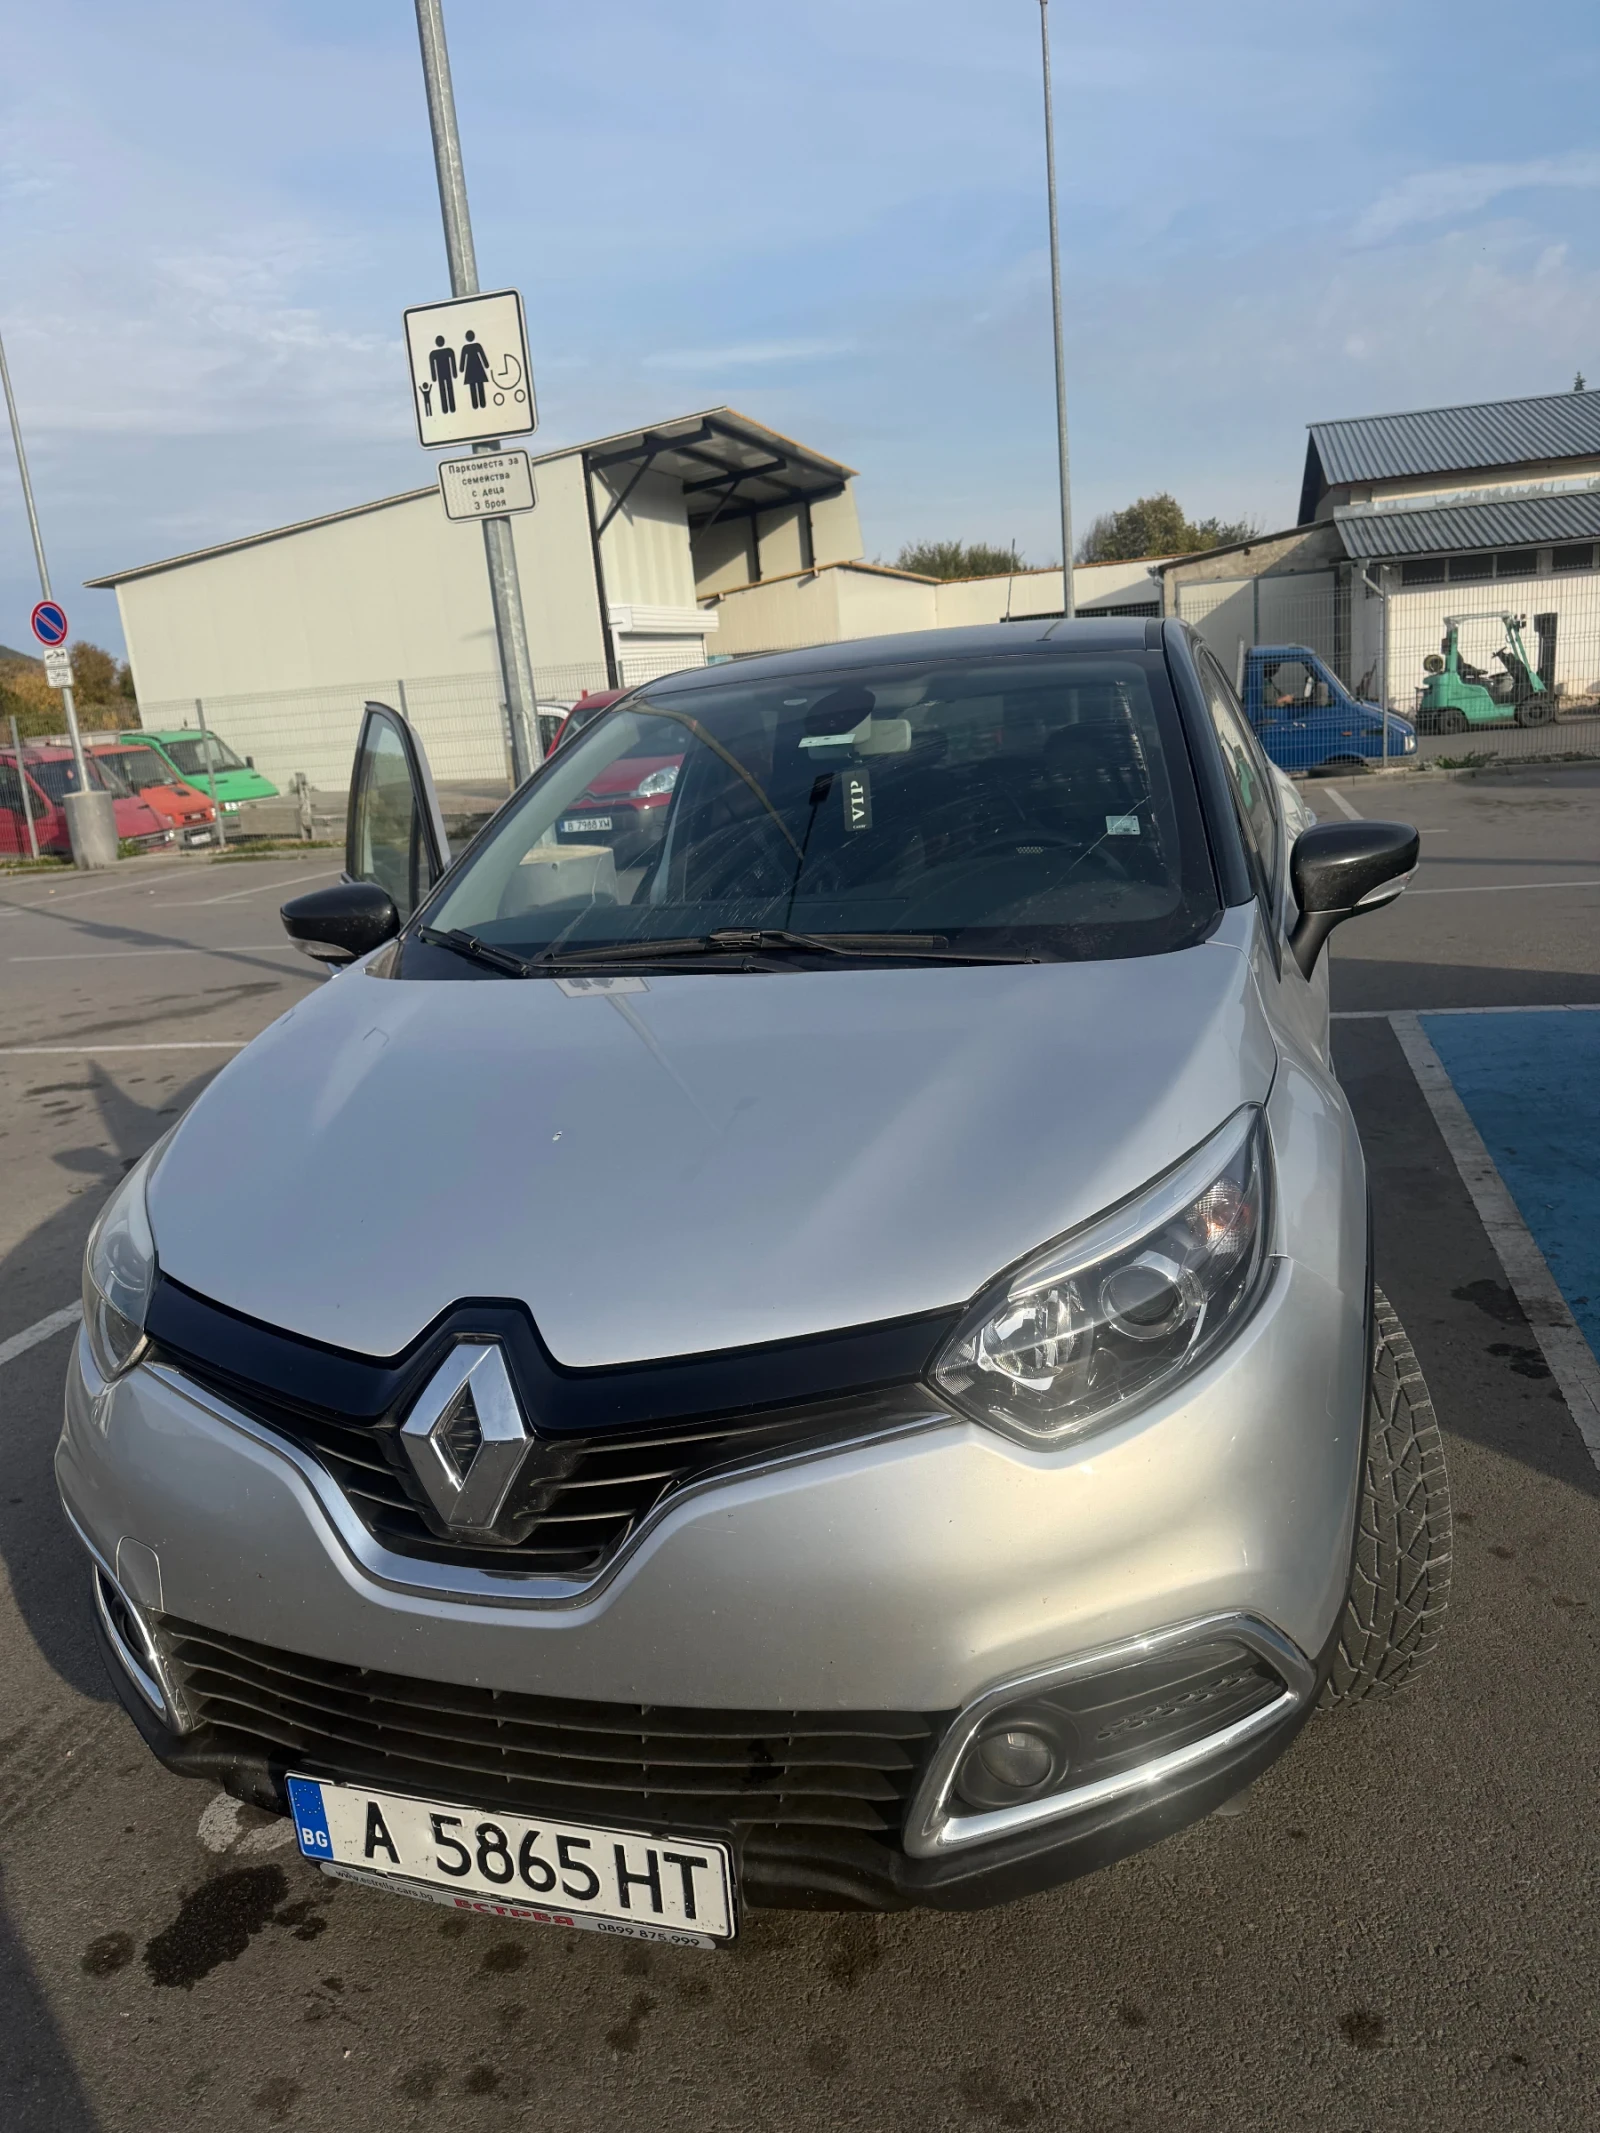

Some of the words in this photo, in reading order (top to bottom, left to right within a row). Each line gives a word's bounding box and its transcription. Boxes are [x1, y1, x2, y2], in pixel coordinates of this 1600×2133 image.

[448, 459, 503, 474] Паркоместа
[508, 457, 519, 465] за
[462, 472, 510, 485] семейства
[482, 486, 505, 497] деца
[474, 502, 480, 510] 3
[485, 499, 506, 509] броя
[850, 780, 865, 822] VIP
[301, 1826, 328, 1848] BG
[363, 1801, 401, 1864] A
[430, 1812, 601, 1900] 5865
[613, 1844, 708, 1920] HT
[597, 1922, 635, 1936] 0899
[639, 1929, 667, 1942] 875
[671, 1934, 701, 1947] 999
